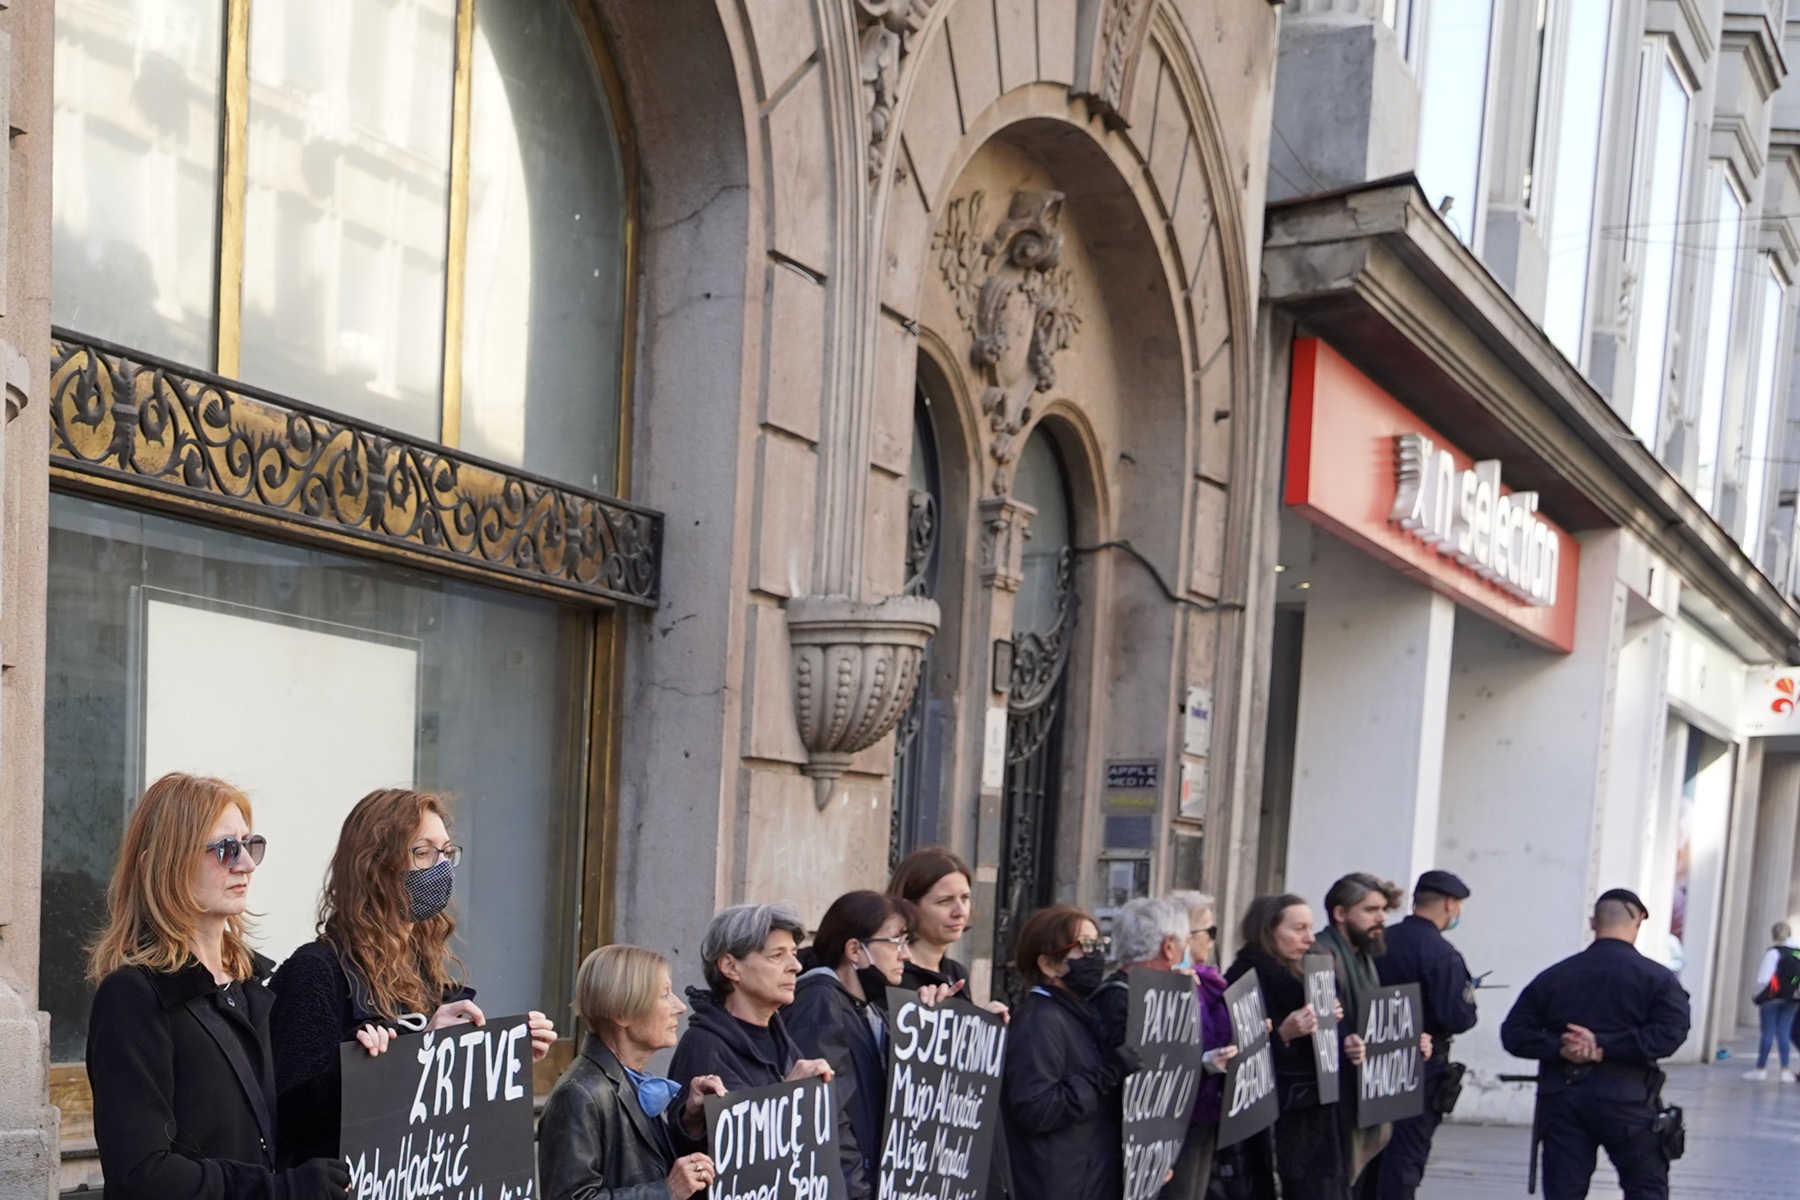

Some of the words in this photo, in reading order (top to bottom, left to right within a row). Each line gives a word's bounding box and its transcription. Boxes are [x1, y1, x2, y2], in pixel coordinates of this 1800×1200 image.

[1458, 458, 1559, 608] selection
[1107, 777, 1157, 787] MEDIA
[1108, 765, 1157, 776] APPLE
[894, 1002, 1007, 1078] SJEVERINU
[1363, 990, 1415, 1044] ALIJA
[409, 1023, 528, 1125] ŽRTVE
[889, 1063, 934, 1131] Mujo
[1361, 1045, 1419, 1101] MANDAL
[715, 1087, 805, 1175] OTMICE
[814, 1083, 831, 1146] U
[881, 1118, 928, 1187] Alija
[928, 1125, 974, 1180] Mandal
